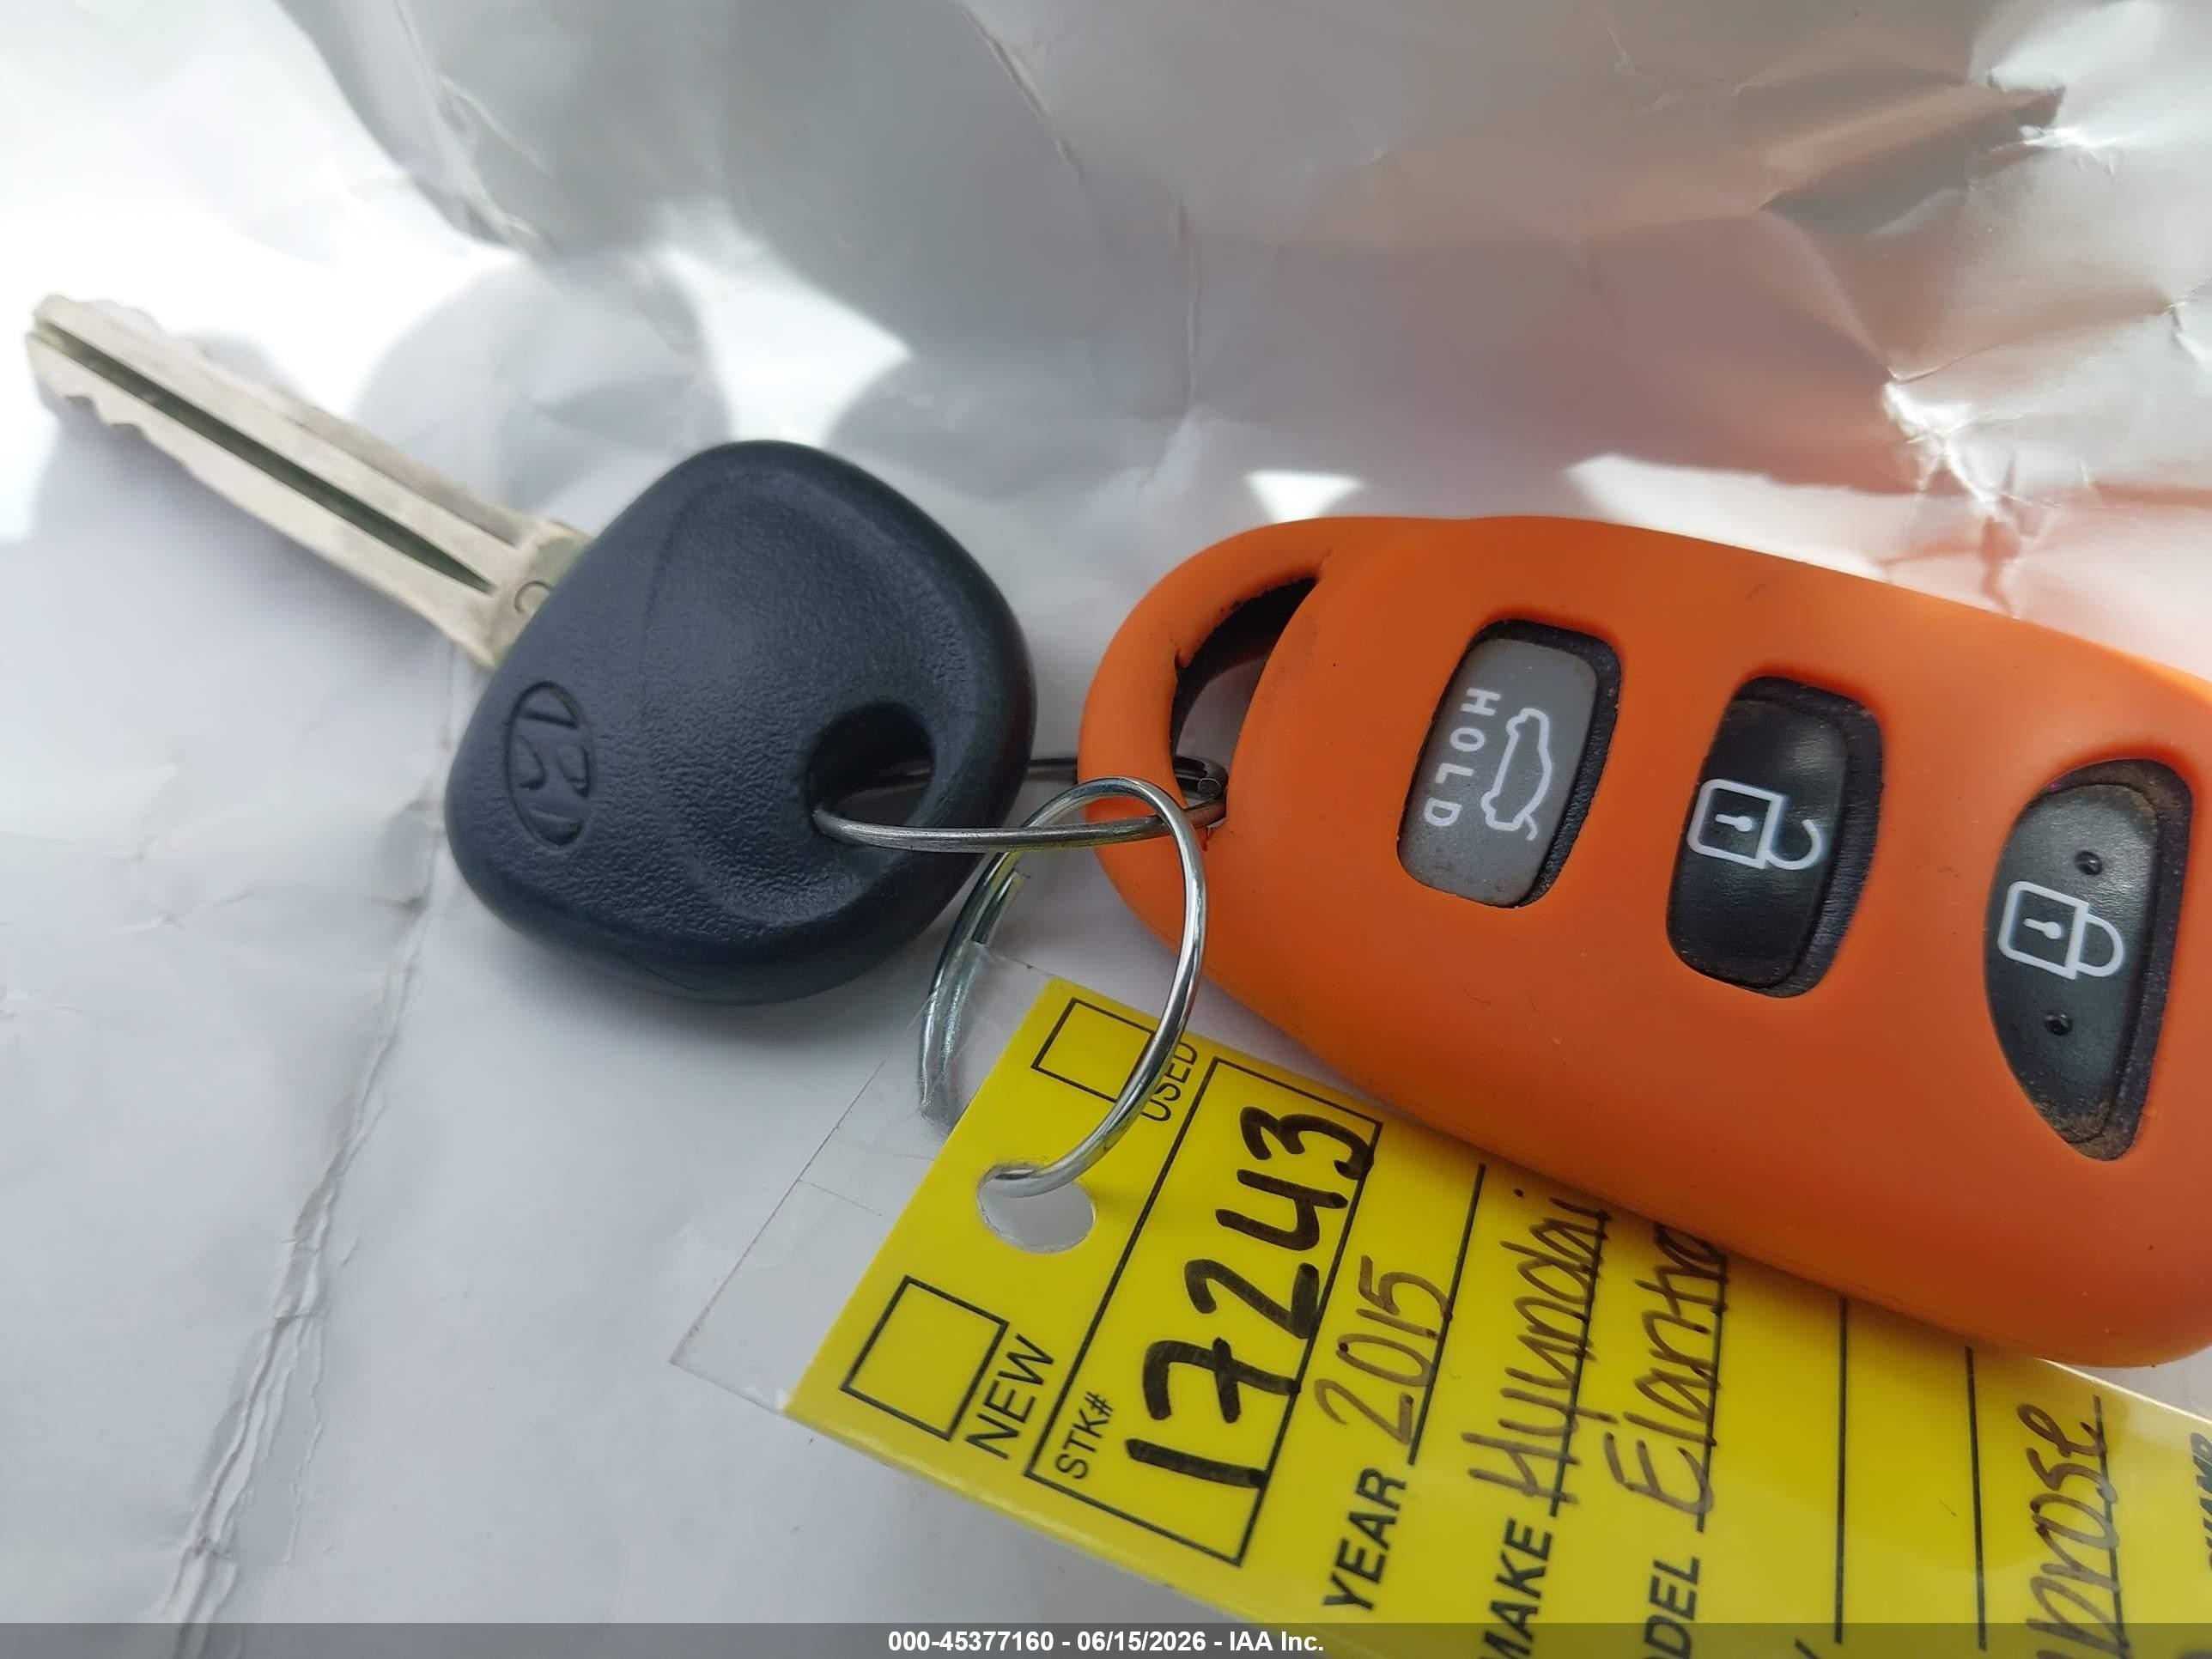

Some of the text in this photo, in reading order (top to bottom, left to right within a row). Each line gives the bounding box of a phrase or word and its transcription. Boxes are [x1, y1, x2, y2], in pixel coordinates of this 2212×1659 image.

[1424, 687, 1501, 827] HOLD
[1140, 1041, 1198, 1122] USED
[964, 1334, 1054, 1460] NEW
[1055, 1106, 1376, 1489] STK# 17243
[1462, 1188, 1620, 1505] Hyundai
[1314, 1255, 1454, 1611] YEAR 2015
